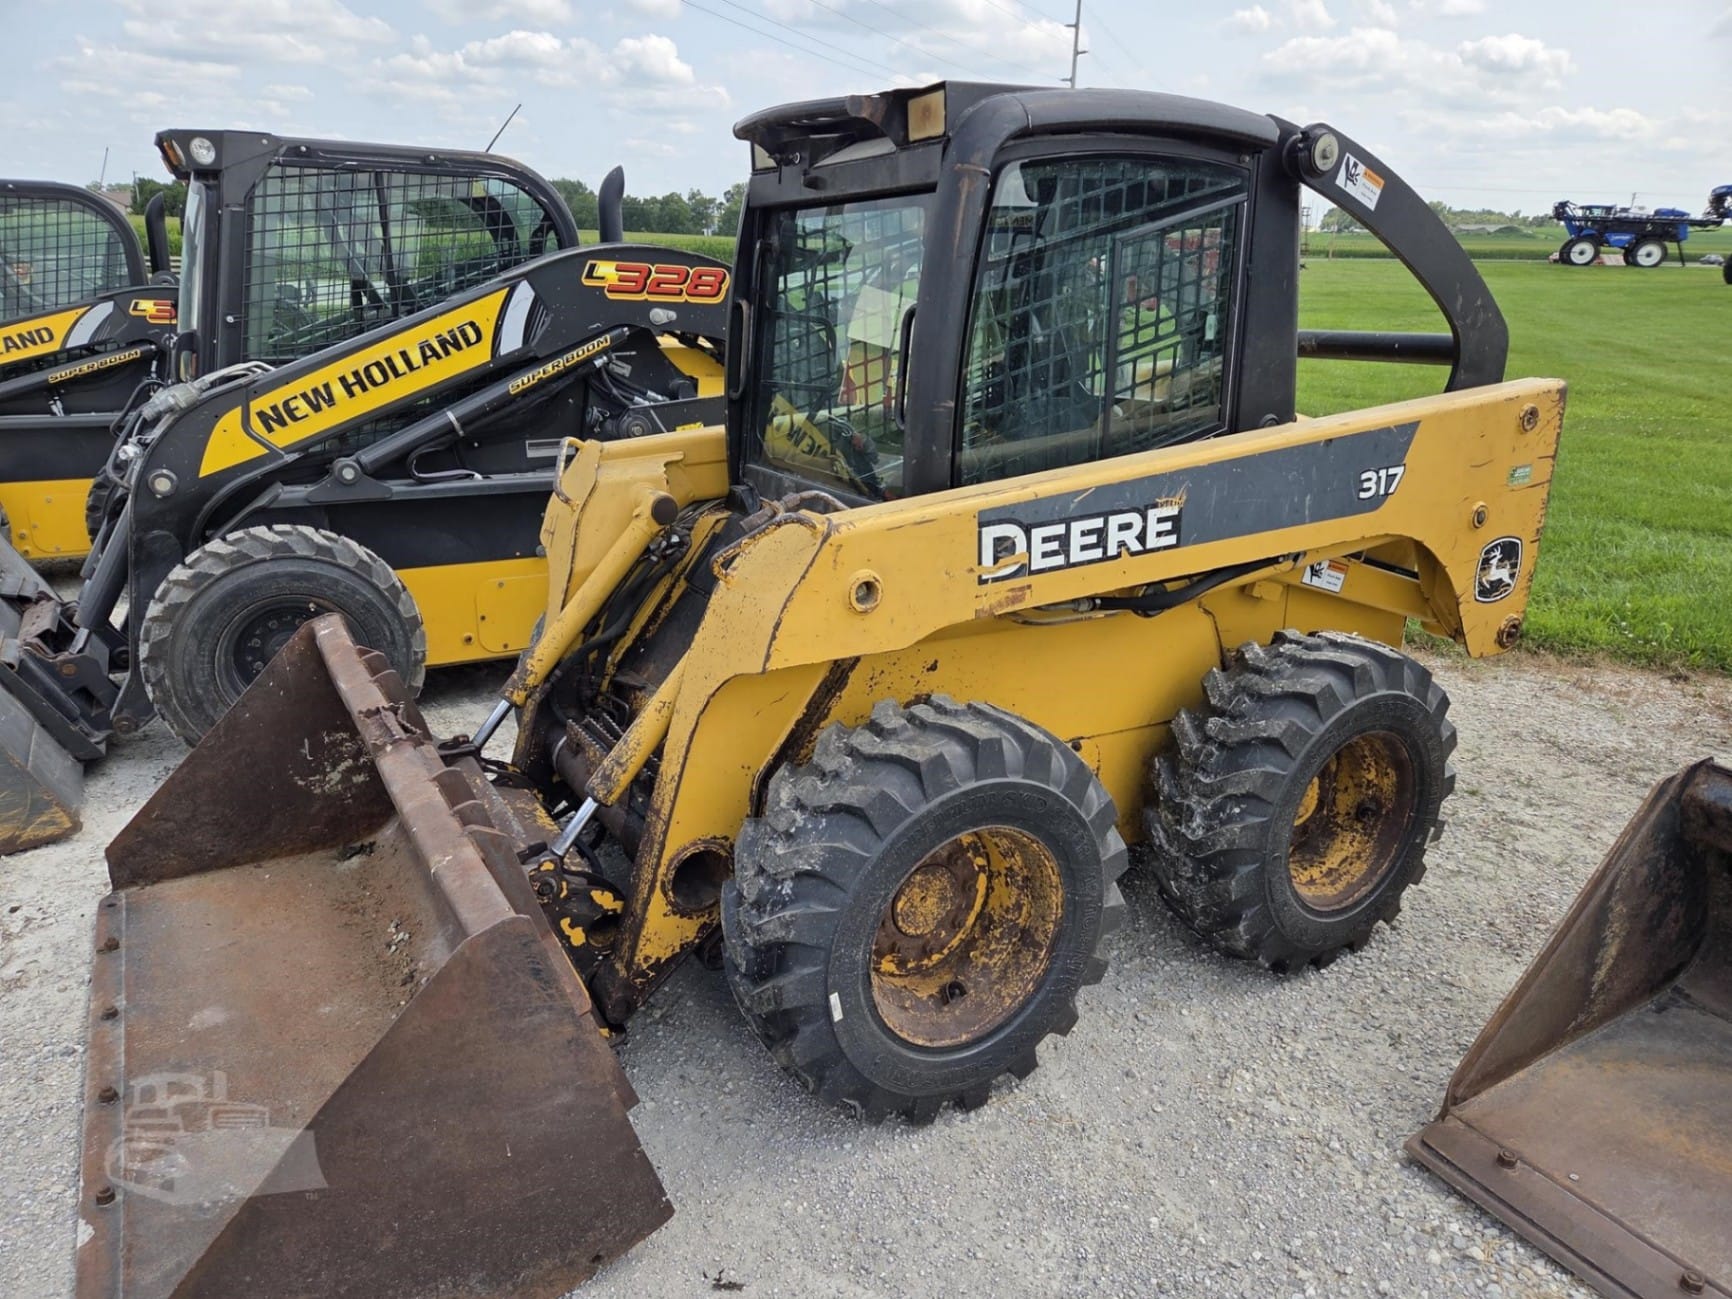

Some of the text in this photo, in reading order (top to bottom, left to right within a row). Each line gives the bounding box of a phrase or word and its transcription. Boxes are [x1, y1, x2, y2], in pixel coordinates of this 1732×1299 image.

[583, 261, 730, 303] L328
[0, 326, 54, 354] AND
[49, 349, 140, 383] SUPER BOOM
[255, 320, 483, 434] NEW HOLLAND
[509, 335, 611, 394] SUPER BOOM
[1358, 464, 1406, 500] 317
[980, 507, 1181, 580] DEERE
